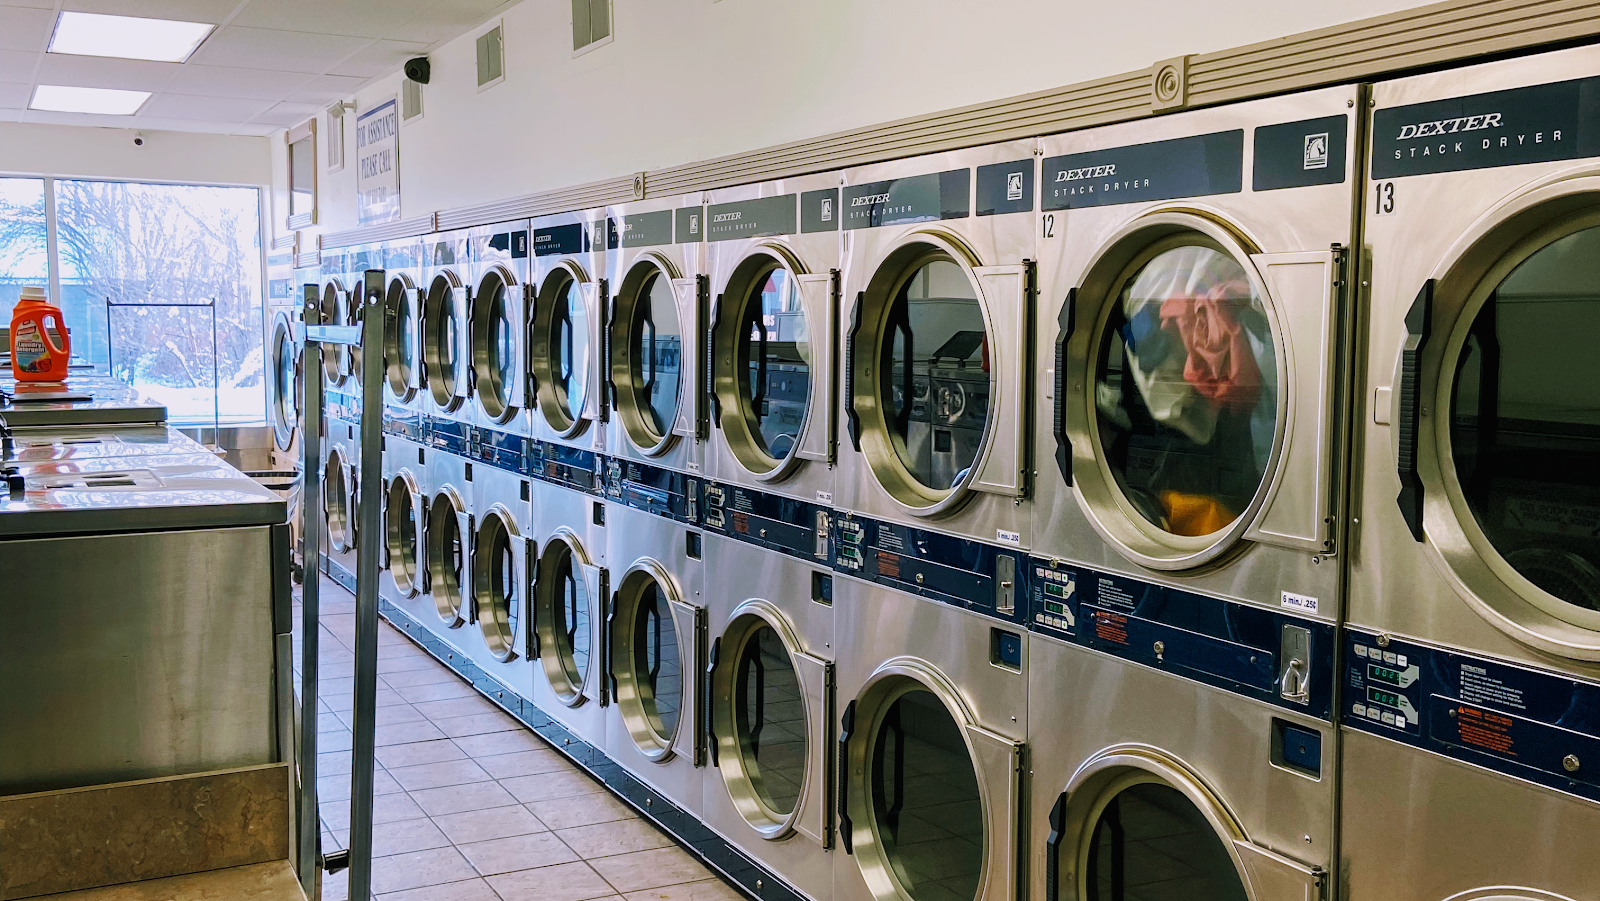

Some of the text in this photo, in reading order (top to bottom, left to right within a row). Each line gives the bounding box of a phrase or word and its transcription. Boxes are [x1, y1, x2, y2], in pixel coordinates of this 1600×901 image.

[358, 113, 394, 148] FOR ASSISTANCE
[1396, 112, 1503, 141] DEXTER
[1394, 129, 1562, 160] STACK DRYER
[361, 148, 391, 180] PLEASE CALL
[1055, 164, 1116, 183] DEXTER
[1054, 178, 1150, 197] STACK DRYER
[850, 192, 891, 207] DEXTER
[1375, 181, 1395, 215] 13
[713, 211, 742, 223] DEXTER
[850, 205, 913, 219] STACK DRYER
[712, 222, 757, 233] STACK DRYER
[1042, 213, 1054, 239] 12
[843, 232, 849, 253] 11
[1283, 595, 1287, 603] 6
